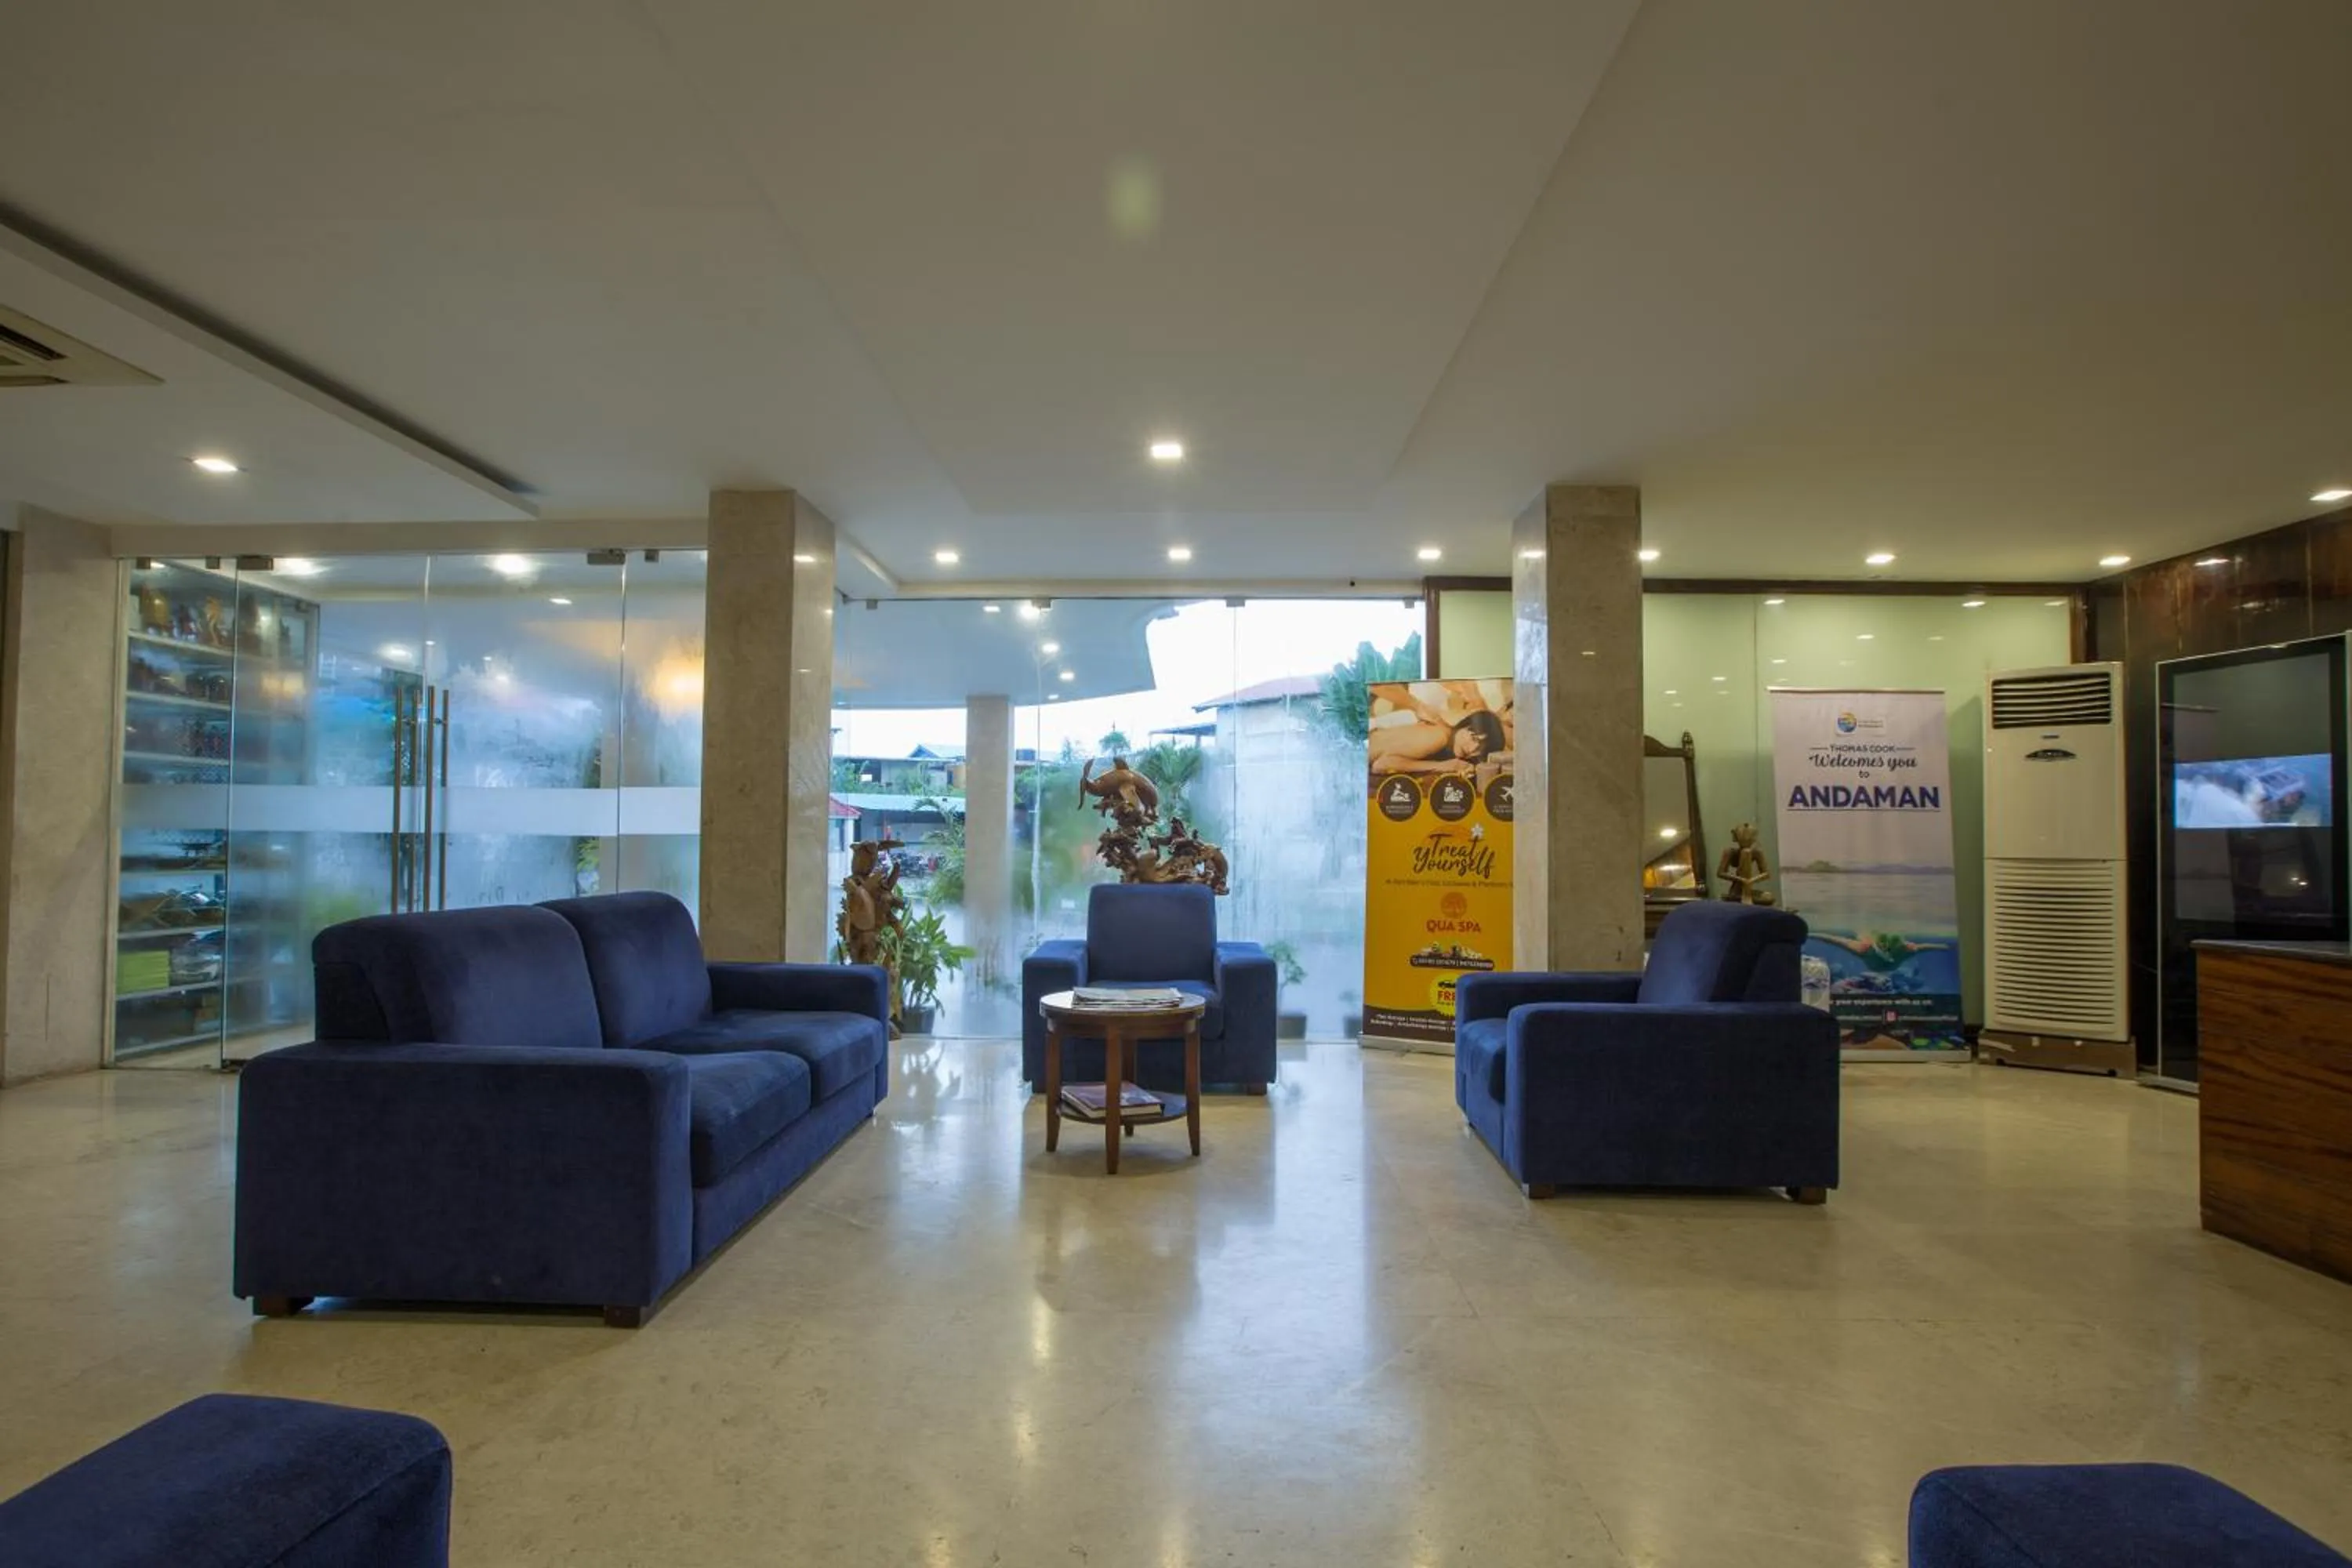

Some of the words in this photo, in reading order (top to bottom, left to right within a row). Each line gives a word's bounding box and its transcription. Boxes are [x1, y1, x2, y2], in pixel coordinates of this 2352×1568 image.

[1809, 753, 1885, 768] Welcomes
[1887, 757, 1918, 772] you
[1858, 770, 1871, 779] to
[1788, 785, 1940, 808] ANDAMAN
[1428, 833, 1486, 858] Treat
[1426, 920, 1455, 933] QUA
[1457, 920, 1482, 933] SPA
